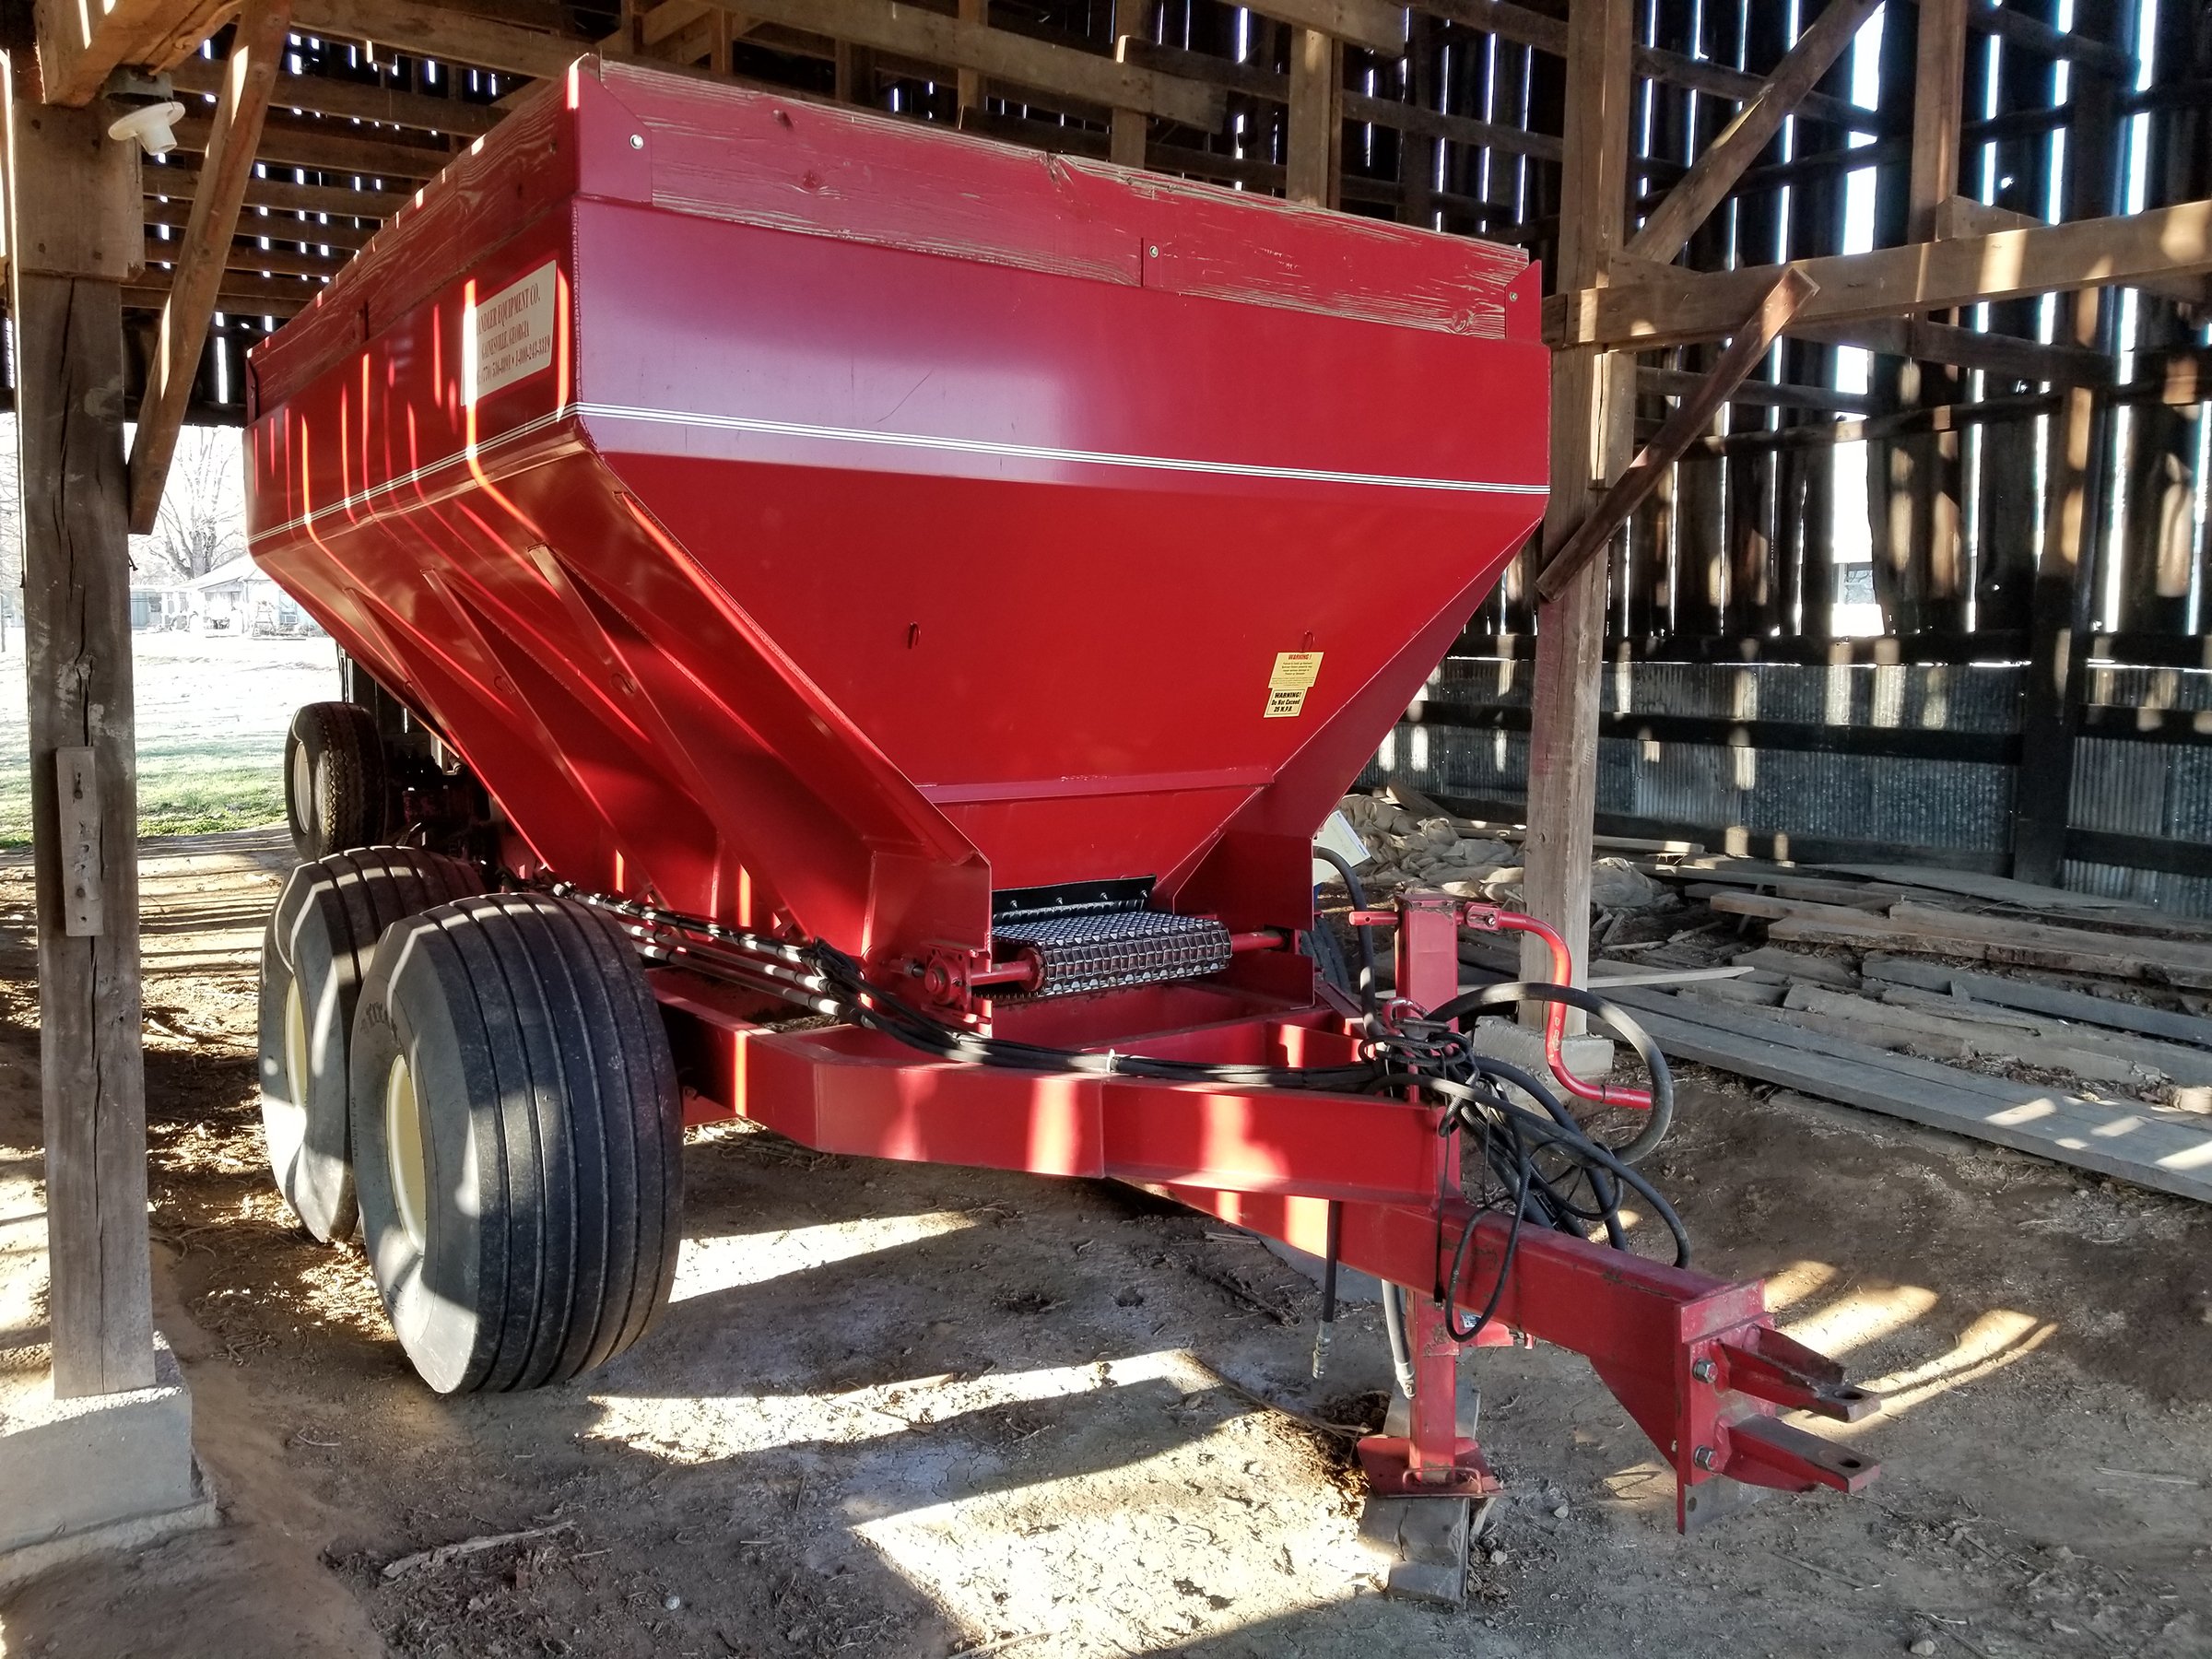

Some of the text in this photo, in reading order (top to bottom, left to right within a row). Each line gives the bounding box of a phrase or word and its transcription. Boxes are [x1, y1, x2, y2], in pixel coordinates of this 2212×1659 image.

[498, 288, 529, 326] EQUIPMENT
[530, 283, 541, 304] CO.
[509, 321, 530, 345] GEORGIA
